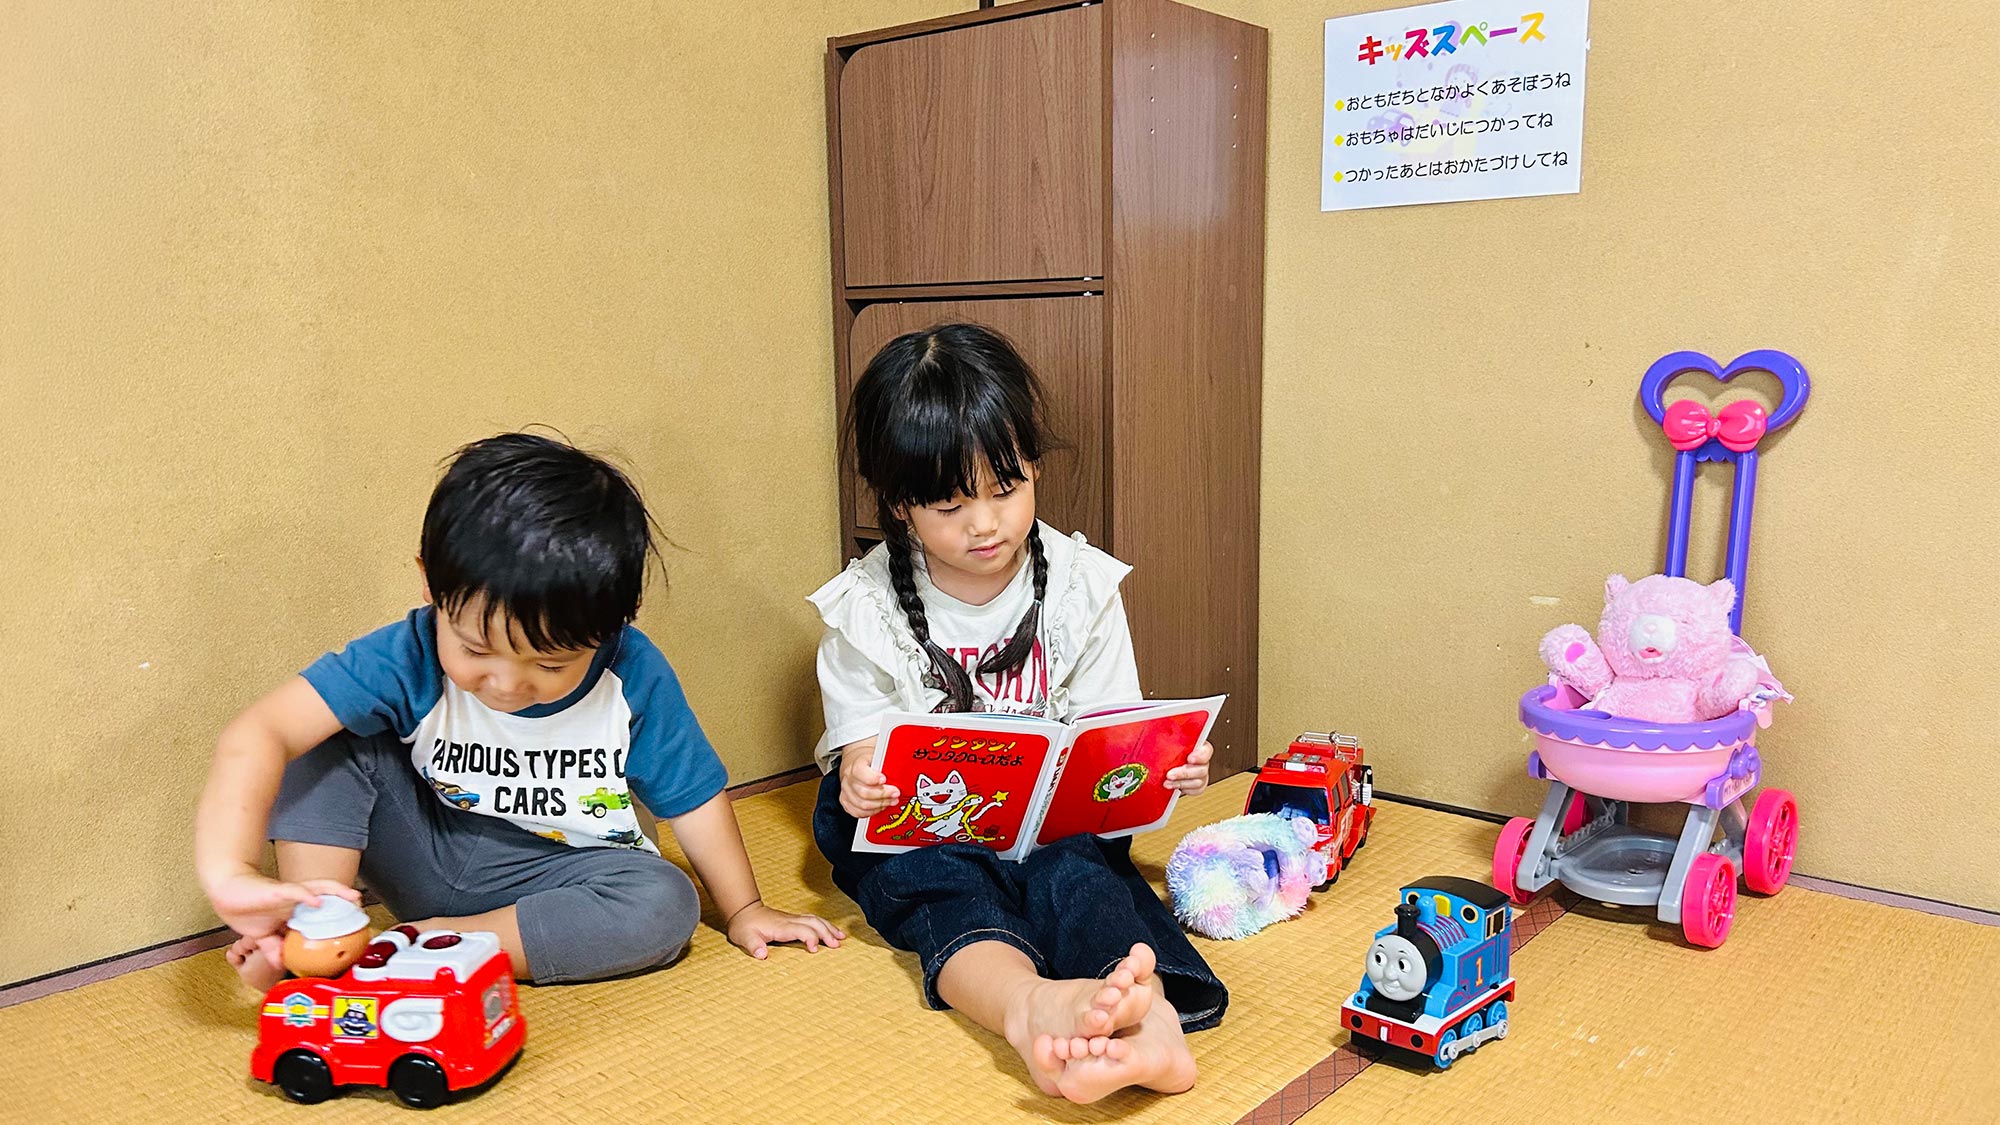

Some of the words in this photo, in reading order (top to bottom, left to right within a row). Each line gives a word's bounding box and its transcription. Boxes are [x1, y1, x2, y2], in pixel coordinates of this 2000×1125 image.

[1358, 12, 1545, 65] キッズスペース
[1346, 72, 1571, 111] おともだちとなかよくあそぼうね
[1346, 112, 1553, 146] おもちゃはだいじにつかってね
[1345, 151, 1568, 183] つかったあとはおかたづけしてね
[525, 748, 606, 779] TYPES
[494, 786, 567, 817] CARS
[1475, 956, 1484, 988] 1
